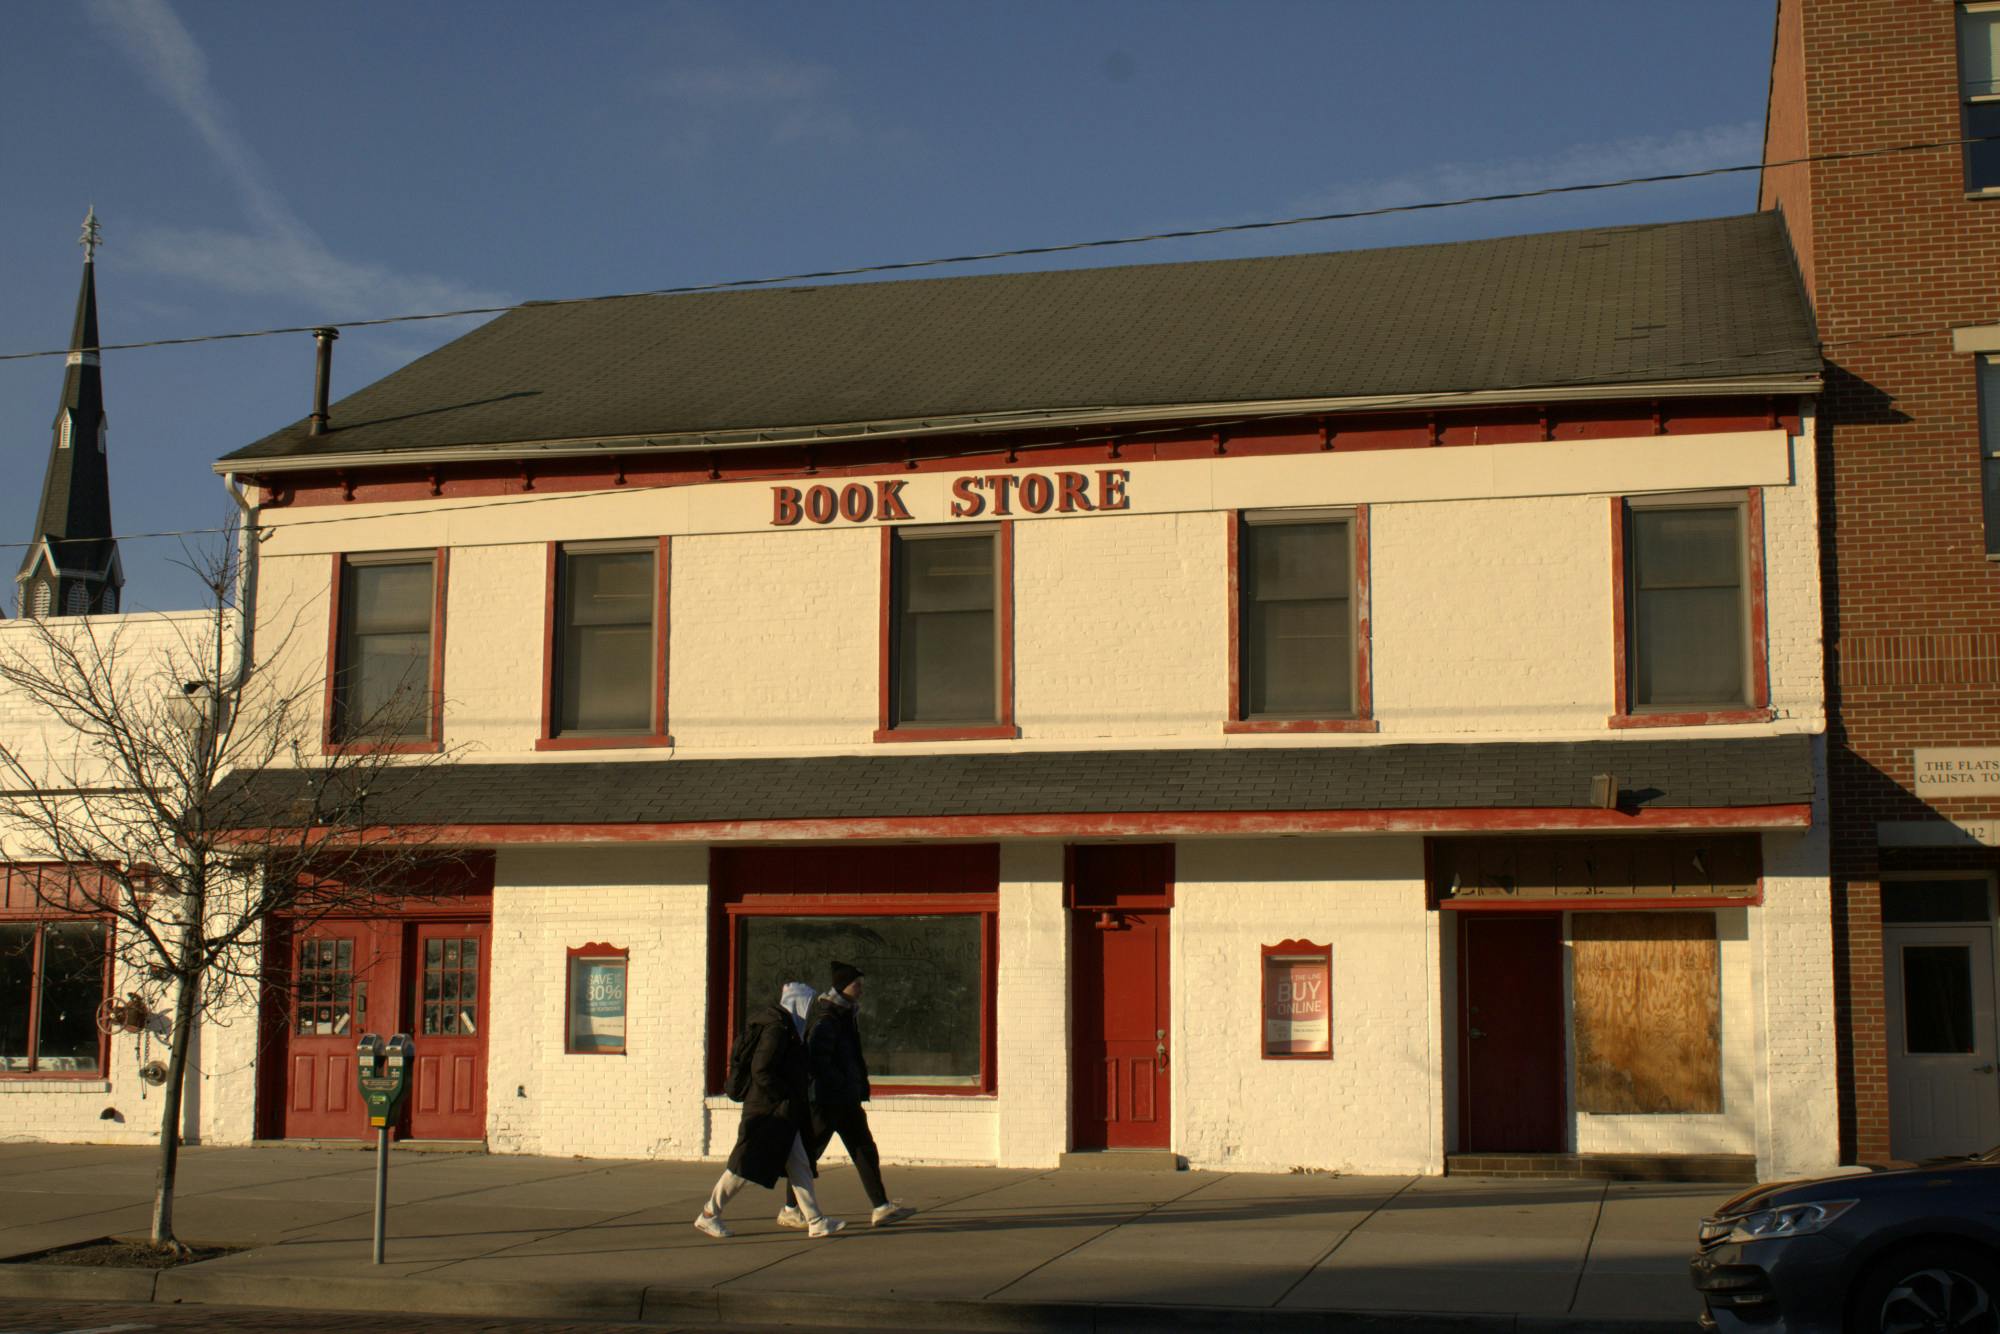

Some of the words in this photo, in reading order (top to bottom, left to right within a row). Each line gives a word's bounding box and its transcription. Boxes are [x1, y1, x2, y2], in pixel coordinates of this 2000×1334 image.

[770, 480, 914, 525] BOOK
[951, 469, 1130, 517] STORE
[1924, 761, 1952, 771] THE
[1959, 760, 1999, 770] FLATS
[1919, 773, 1975, 783] CALISTA
[587, 973, 613, 984] SAVE
[1278, 981, 1321, 1001] BUY
[1278, 1001, 1321, 1015] ONLINE
